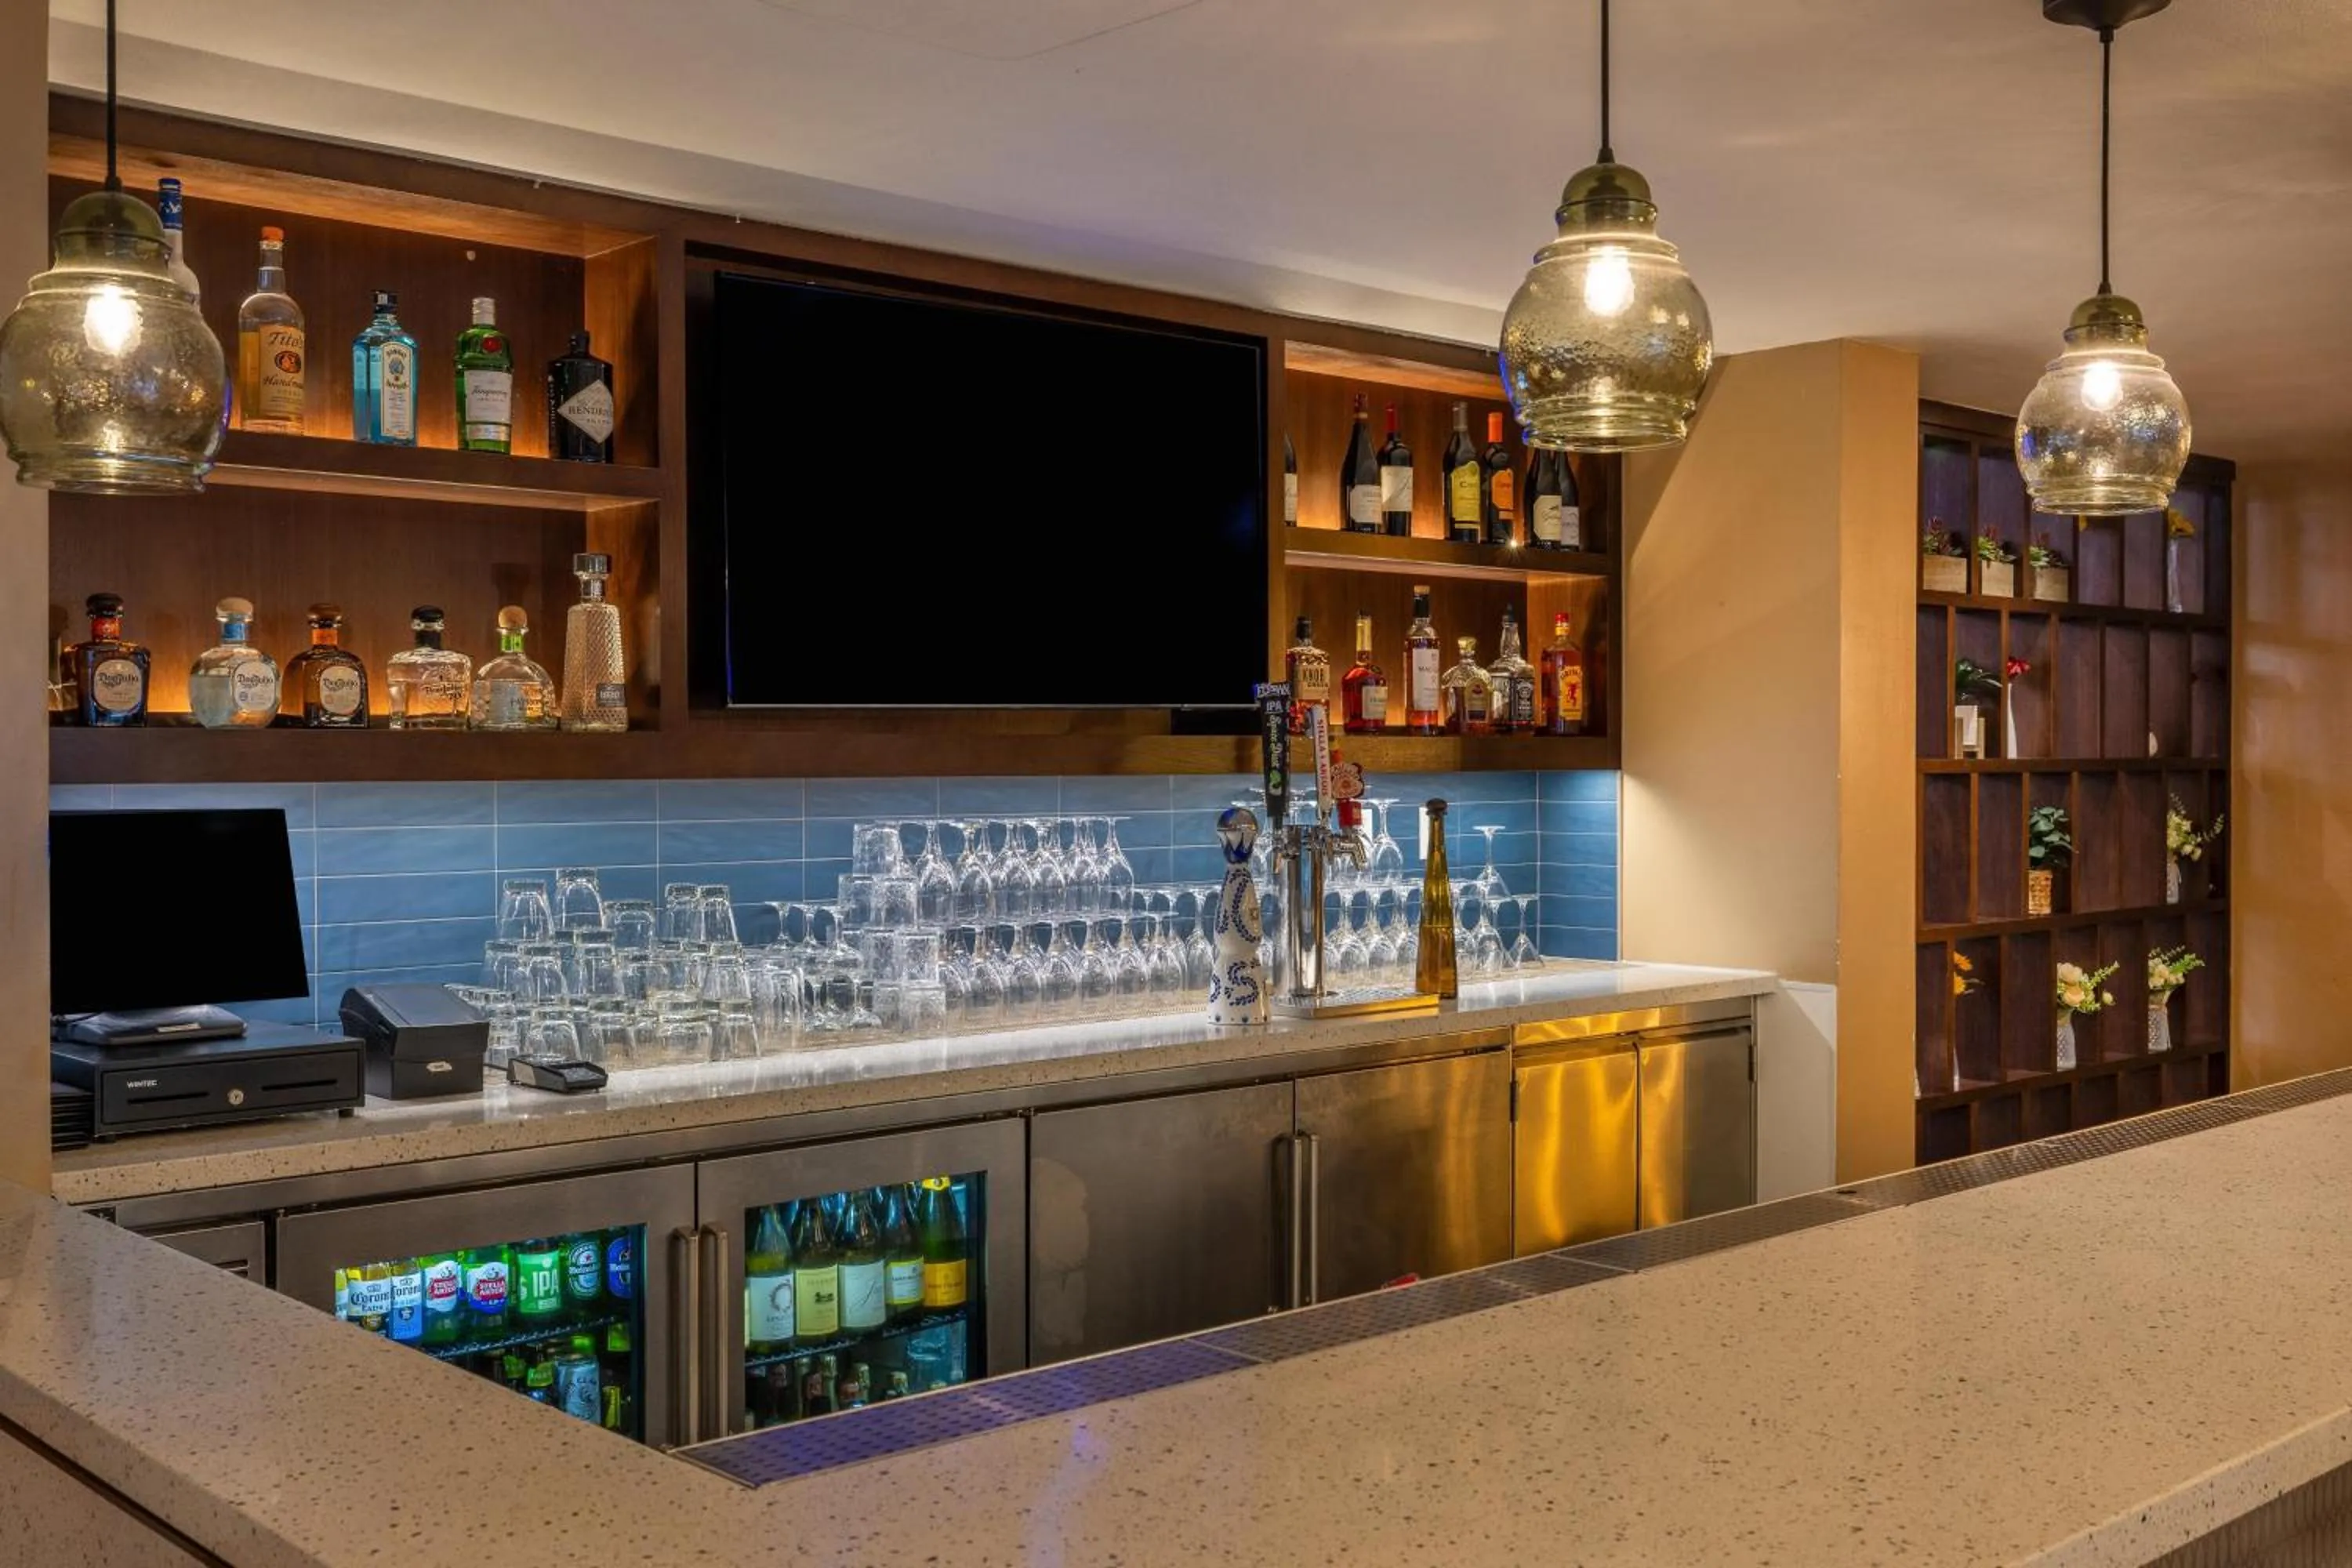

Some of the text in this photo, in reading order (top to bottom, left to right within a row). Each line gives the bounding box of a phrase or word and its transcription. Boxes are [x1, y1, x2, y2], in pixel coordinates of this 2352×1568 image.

[1266, 701, 1283, 712] IPA
[1316, 718, 1328, 752] STELLA
[532, 1269, 560, 1298] IPA
